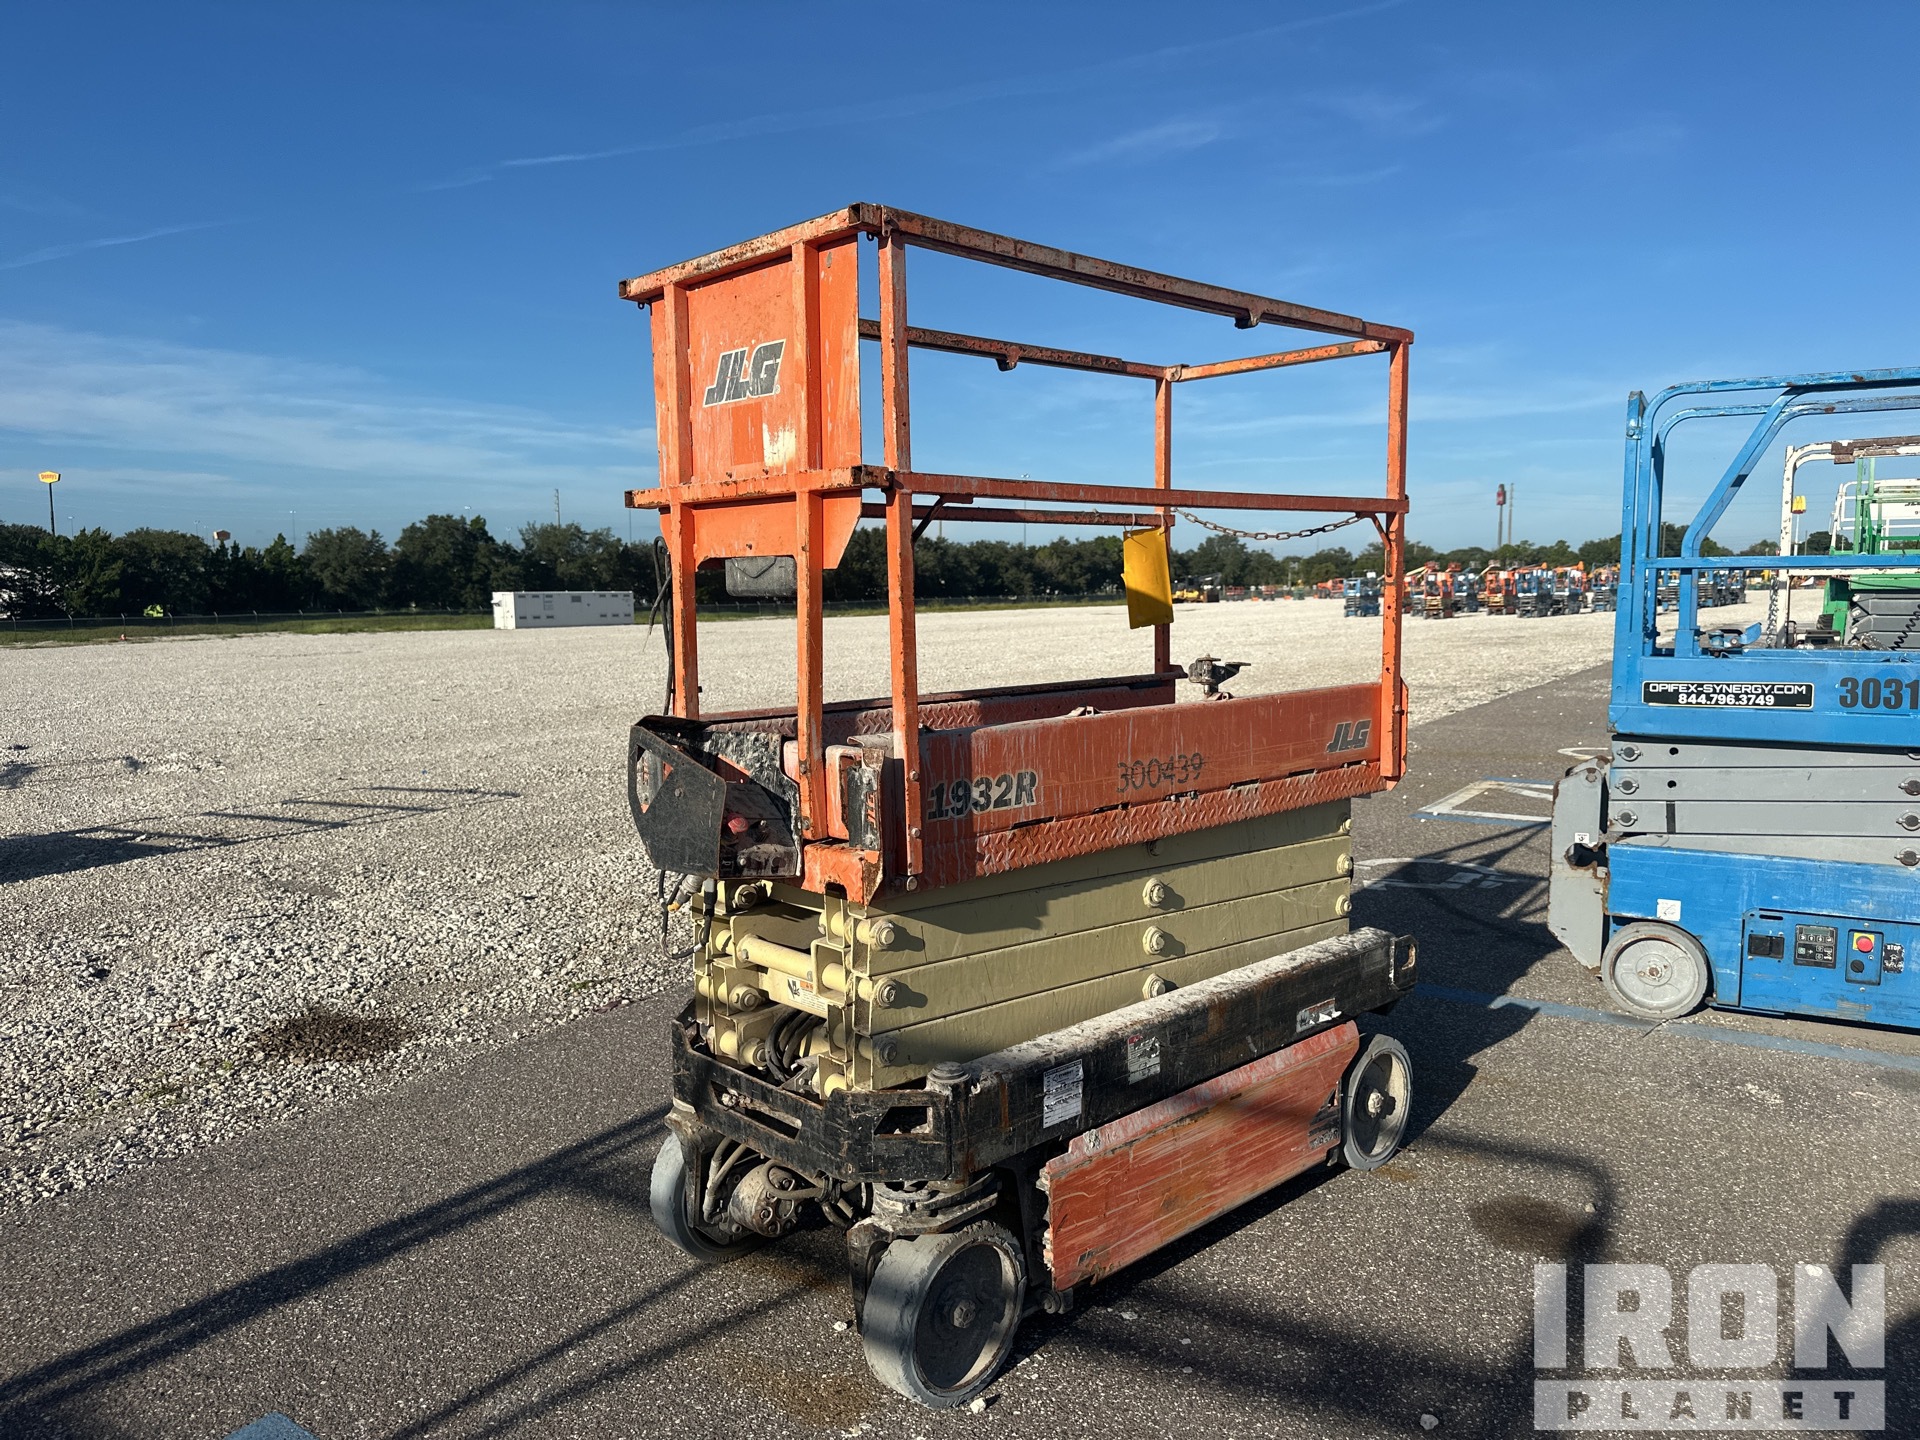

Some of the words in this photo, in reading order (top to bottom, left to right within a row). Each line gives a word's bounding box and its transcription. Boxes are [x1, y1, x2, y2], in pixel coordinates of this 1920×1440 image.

[703, 339, 786, 408] JLG
[1649, 683, 1806, 694] OPIFEX-SYNERGY.COM
[1678, 694, 1775, 705] 844.796.3749
[1839, 677, 1919, 709] 3031
[1325, 719, 1372, 753] JLG
[1117, 753, 1203, 793] 300439
[927, 769, 1038, 821] 1932R
